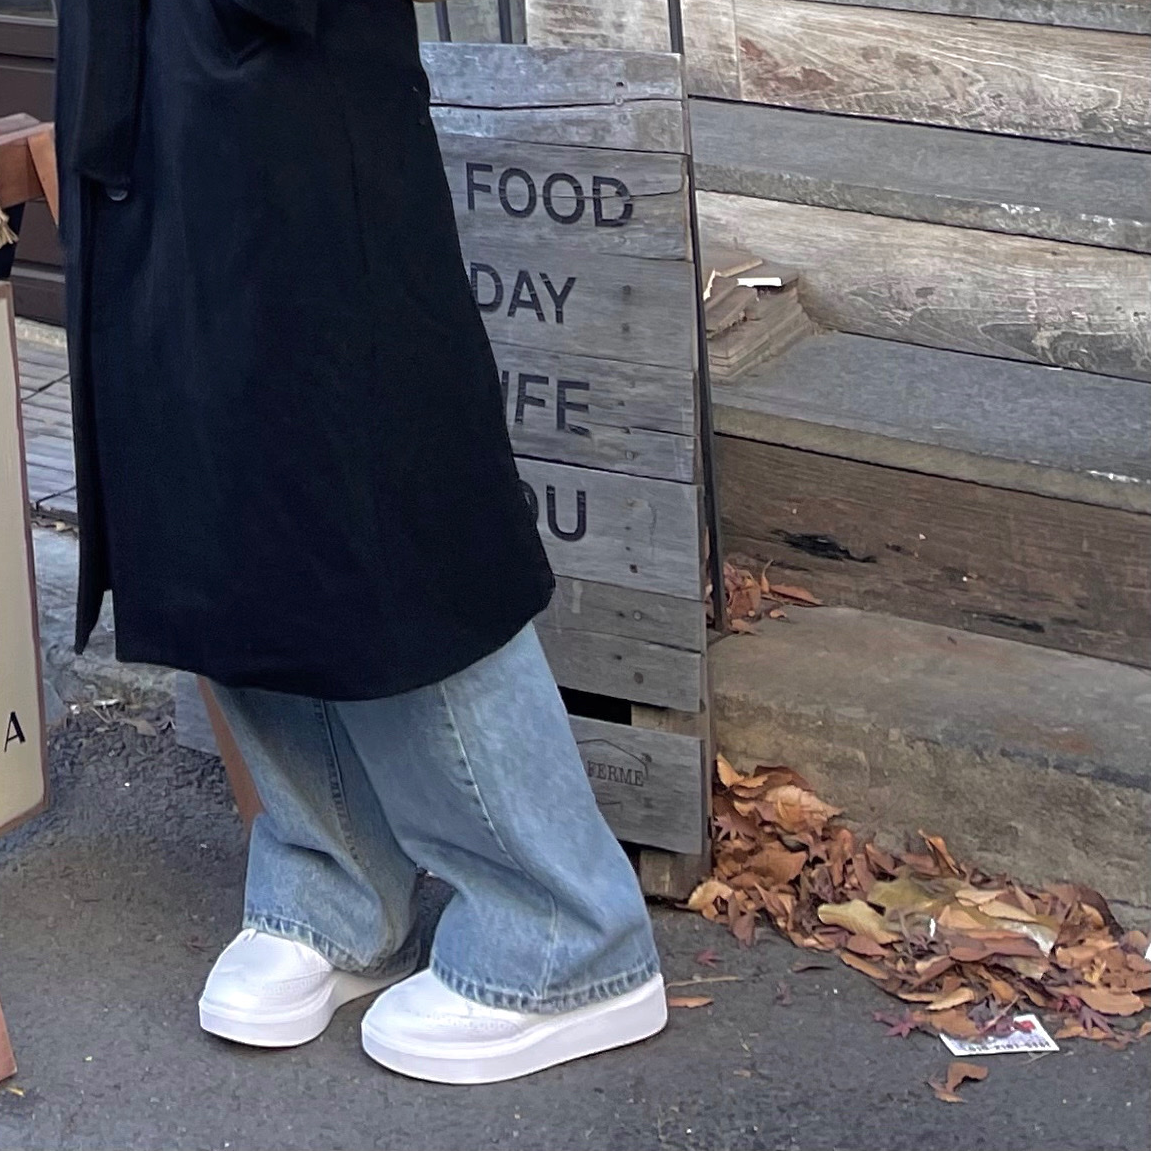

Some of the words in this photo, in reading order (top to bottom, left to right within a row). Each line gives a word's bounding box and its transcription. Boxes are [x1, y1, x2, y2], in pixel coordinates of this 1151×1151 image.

[466, 161, 634, 228] FOOD
[469, 261, 577, 325] DAY
[586, 760, 644, 787] FERME
